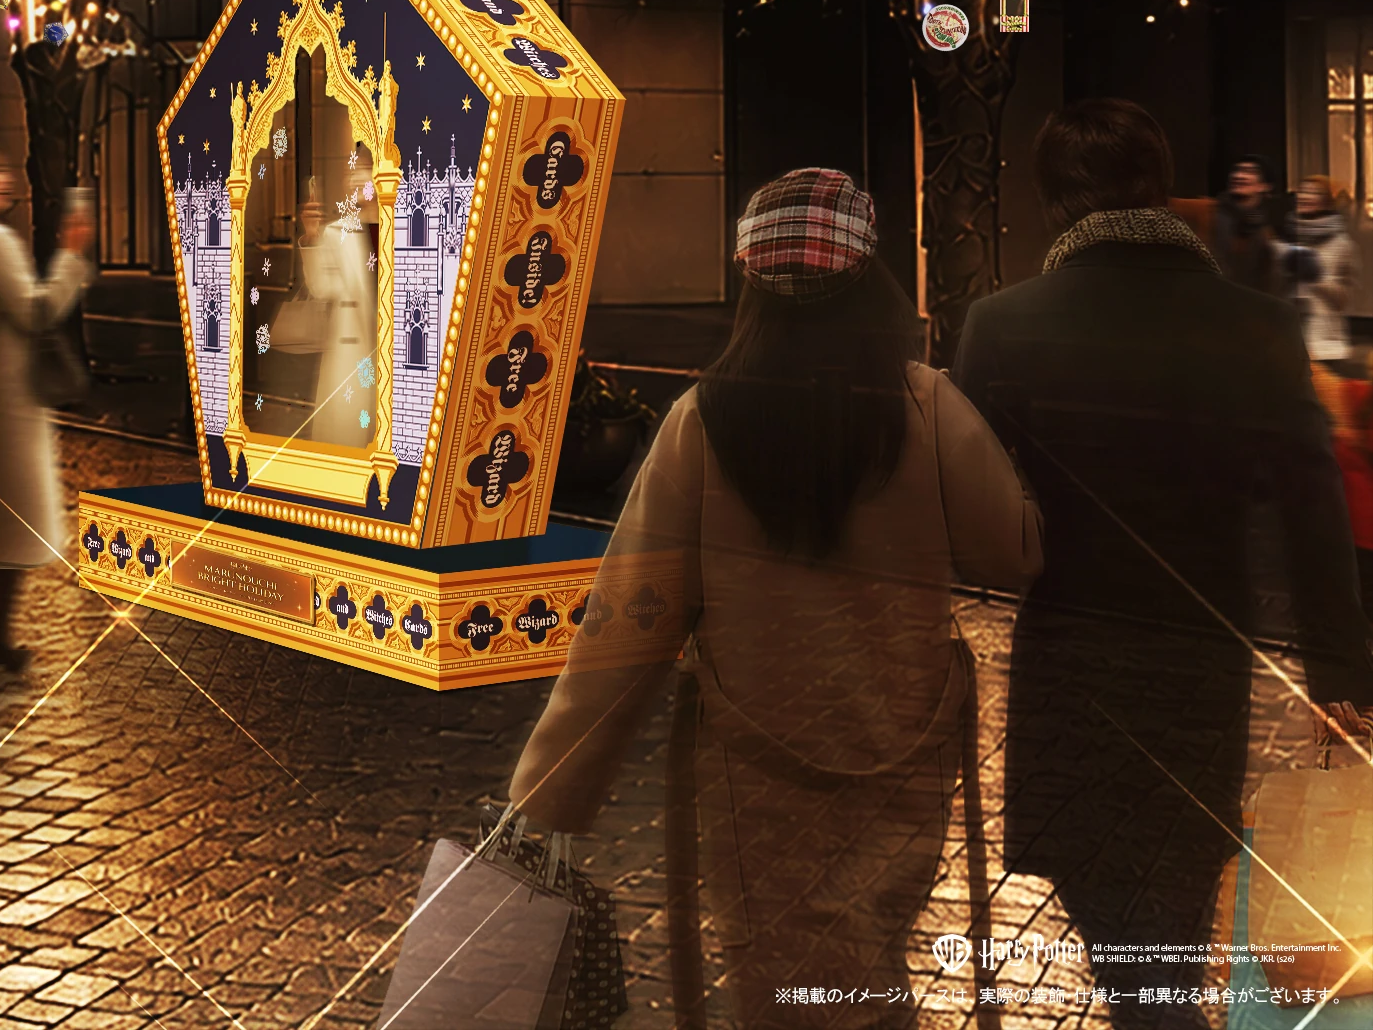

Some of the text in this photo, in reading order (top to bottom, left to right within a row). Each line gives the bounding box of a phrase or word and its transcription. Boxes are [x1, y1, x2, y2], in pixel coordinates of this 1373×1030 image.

[485, 140, 565, 505] Cards Inside! Free Wizard
[197, 571, 237, 590] BRIGHT
[237, 582, 286, 602] HOLIDAY
[203, 564, 279, 591] MARUNOUCHI
[336, 603, 429, 636] and Witches Cards
[467, 622, 495, 638] Free
[517, 614, 559, 631] Wizard
